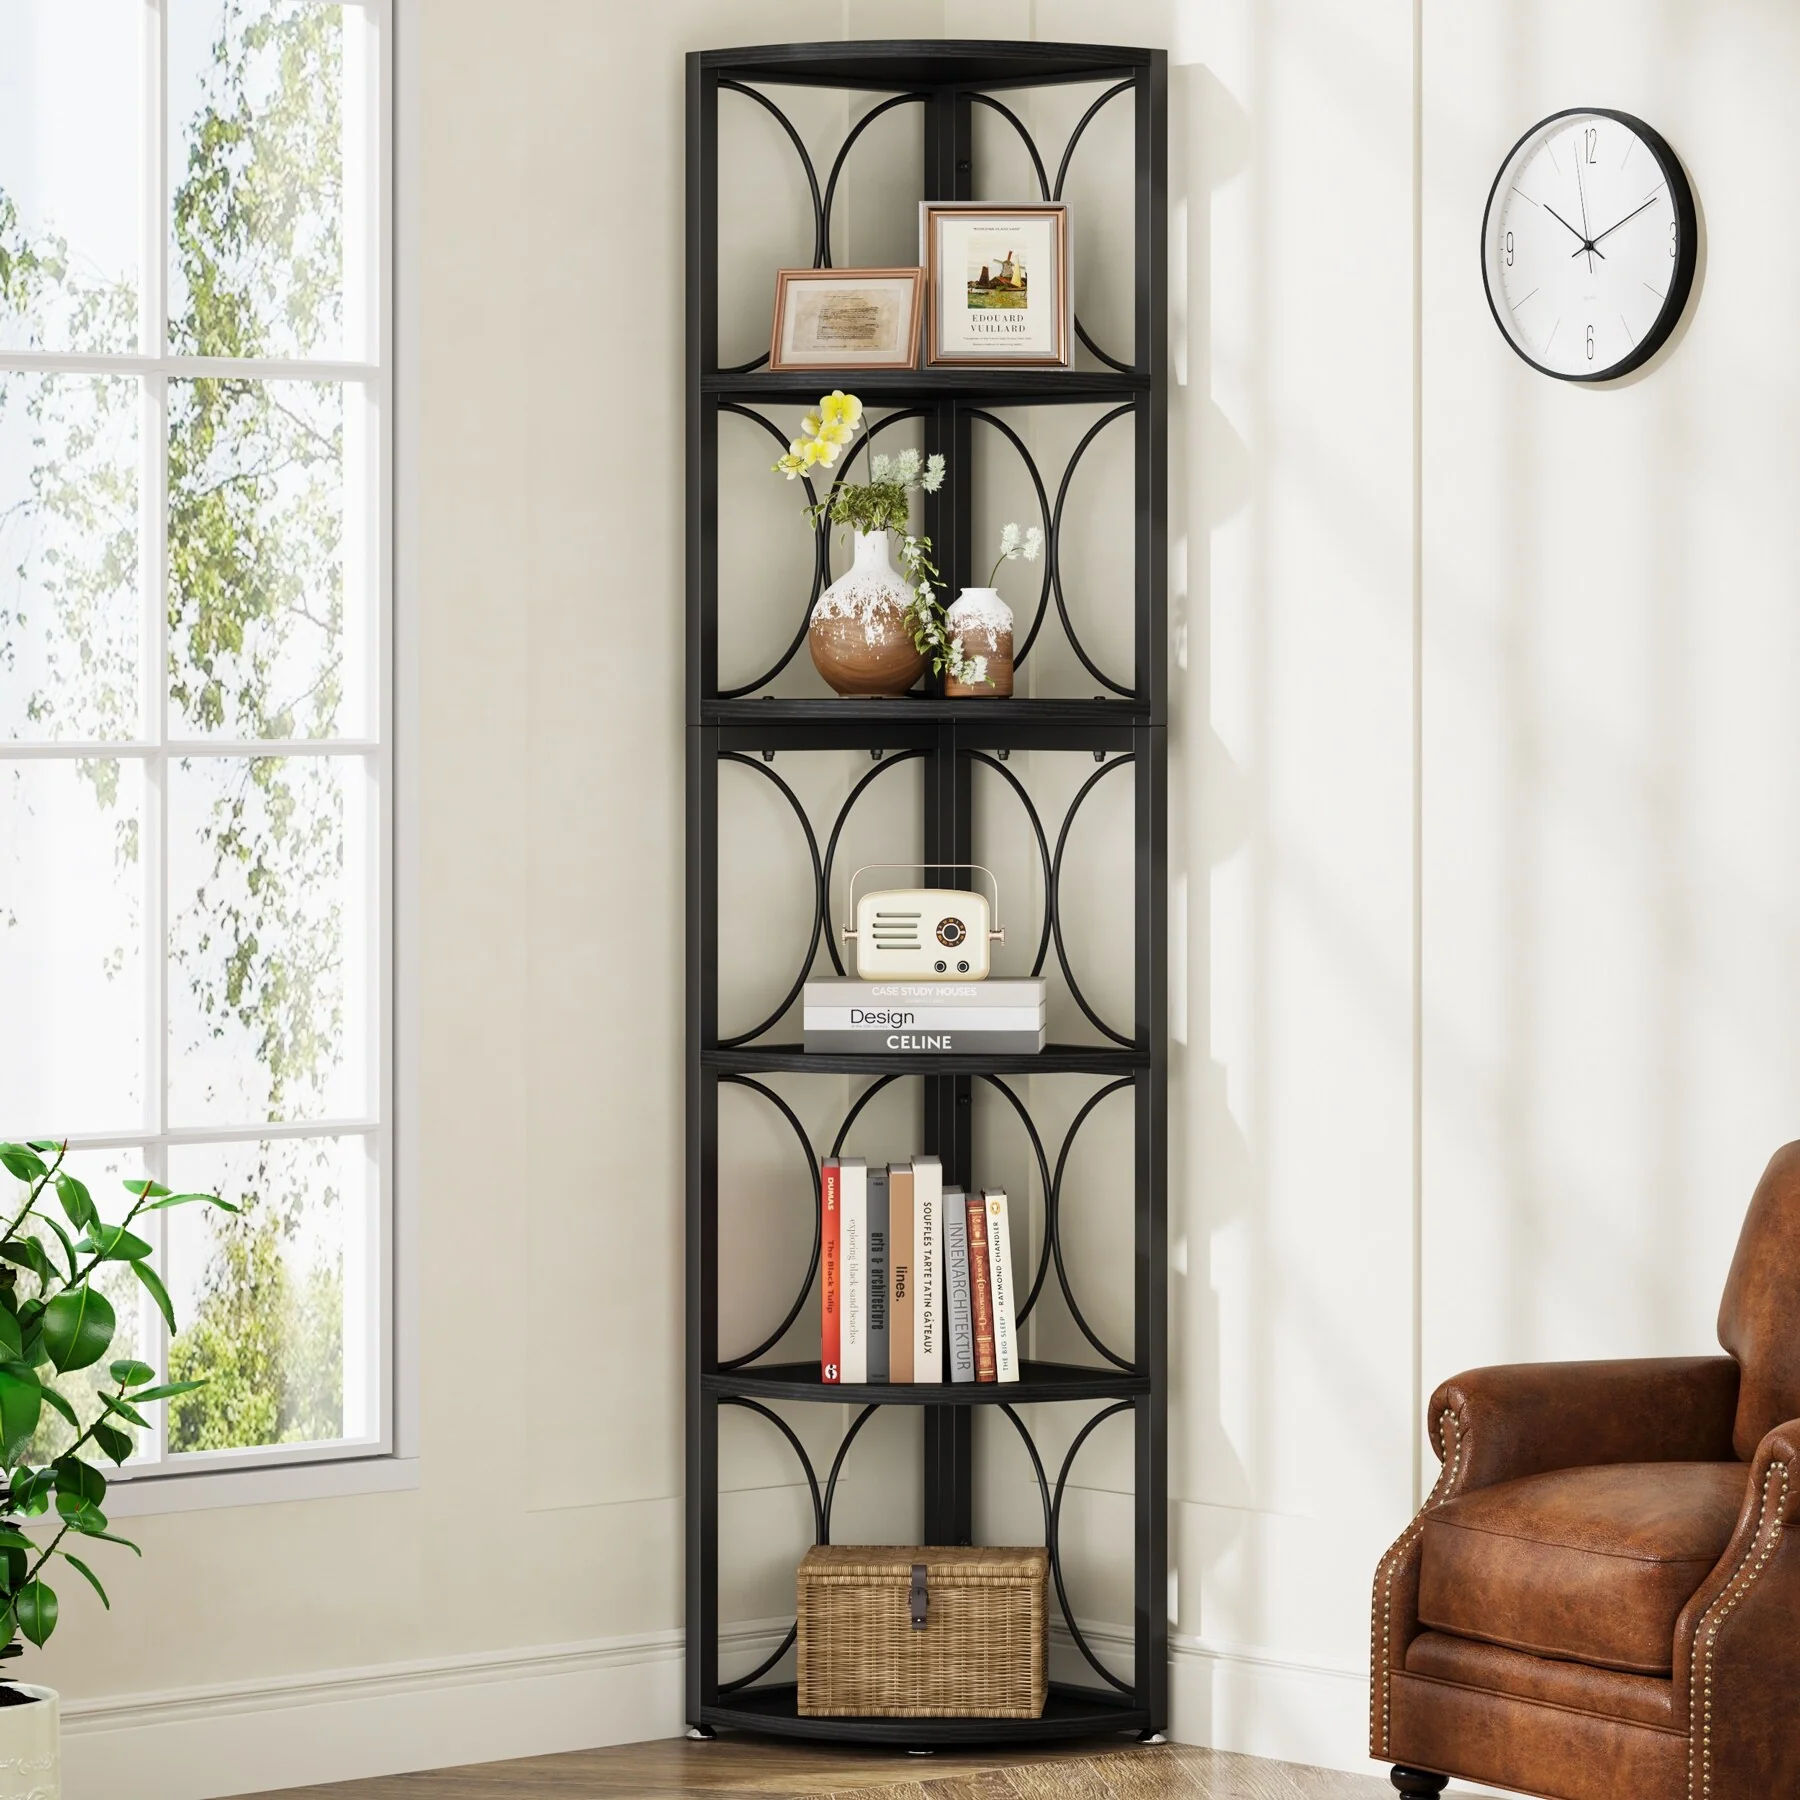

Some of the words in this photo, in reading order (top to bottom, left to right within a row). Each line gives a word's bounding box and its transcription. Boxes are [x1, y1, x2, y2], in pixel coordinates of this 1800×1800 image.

[1584, 128, 1597, 164] 12
[1506, 231, 1514, 267] 9
[1669, 221, 1677, 258] 3
[971, 324, 1026, 333] VUILLARD
[972, 314, 1024, 322] EDOUARD
[1586, 324, 1594, 360] 6
[871, 986, 899, 996] CASE
[901, 986, 933, 996] STUDY
[935, 986, 977, 996] HOUSES
[850, 1009, 914, 1029] Design
[886, 1035, 952, 1050] CELINE
[846, 1219, 858, 1261] exploring
[871, 1233, 886, 1252] arts
[992, 1221, 1002, 1263] CHANDLER
[849, 1263, 859, 1286] black
[923, 1250, 932, 1278] TARTE
[849, 1289, 859, 1309] sand
[871, 1269, 887, 1330] architecture
[896, 1266, 908, 1302] lines.
[923, 1281, 932, 1308] TATIN
[949, 1222, 971, 1370] INNENARCHITEKTUR
[996, 1265, 1004, 1306] RAYMOND
[826, 1290, 834, 1314] Tulip
[849, 1310, 859, 1345] beaches
